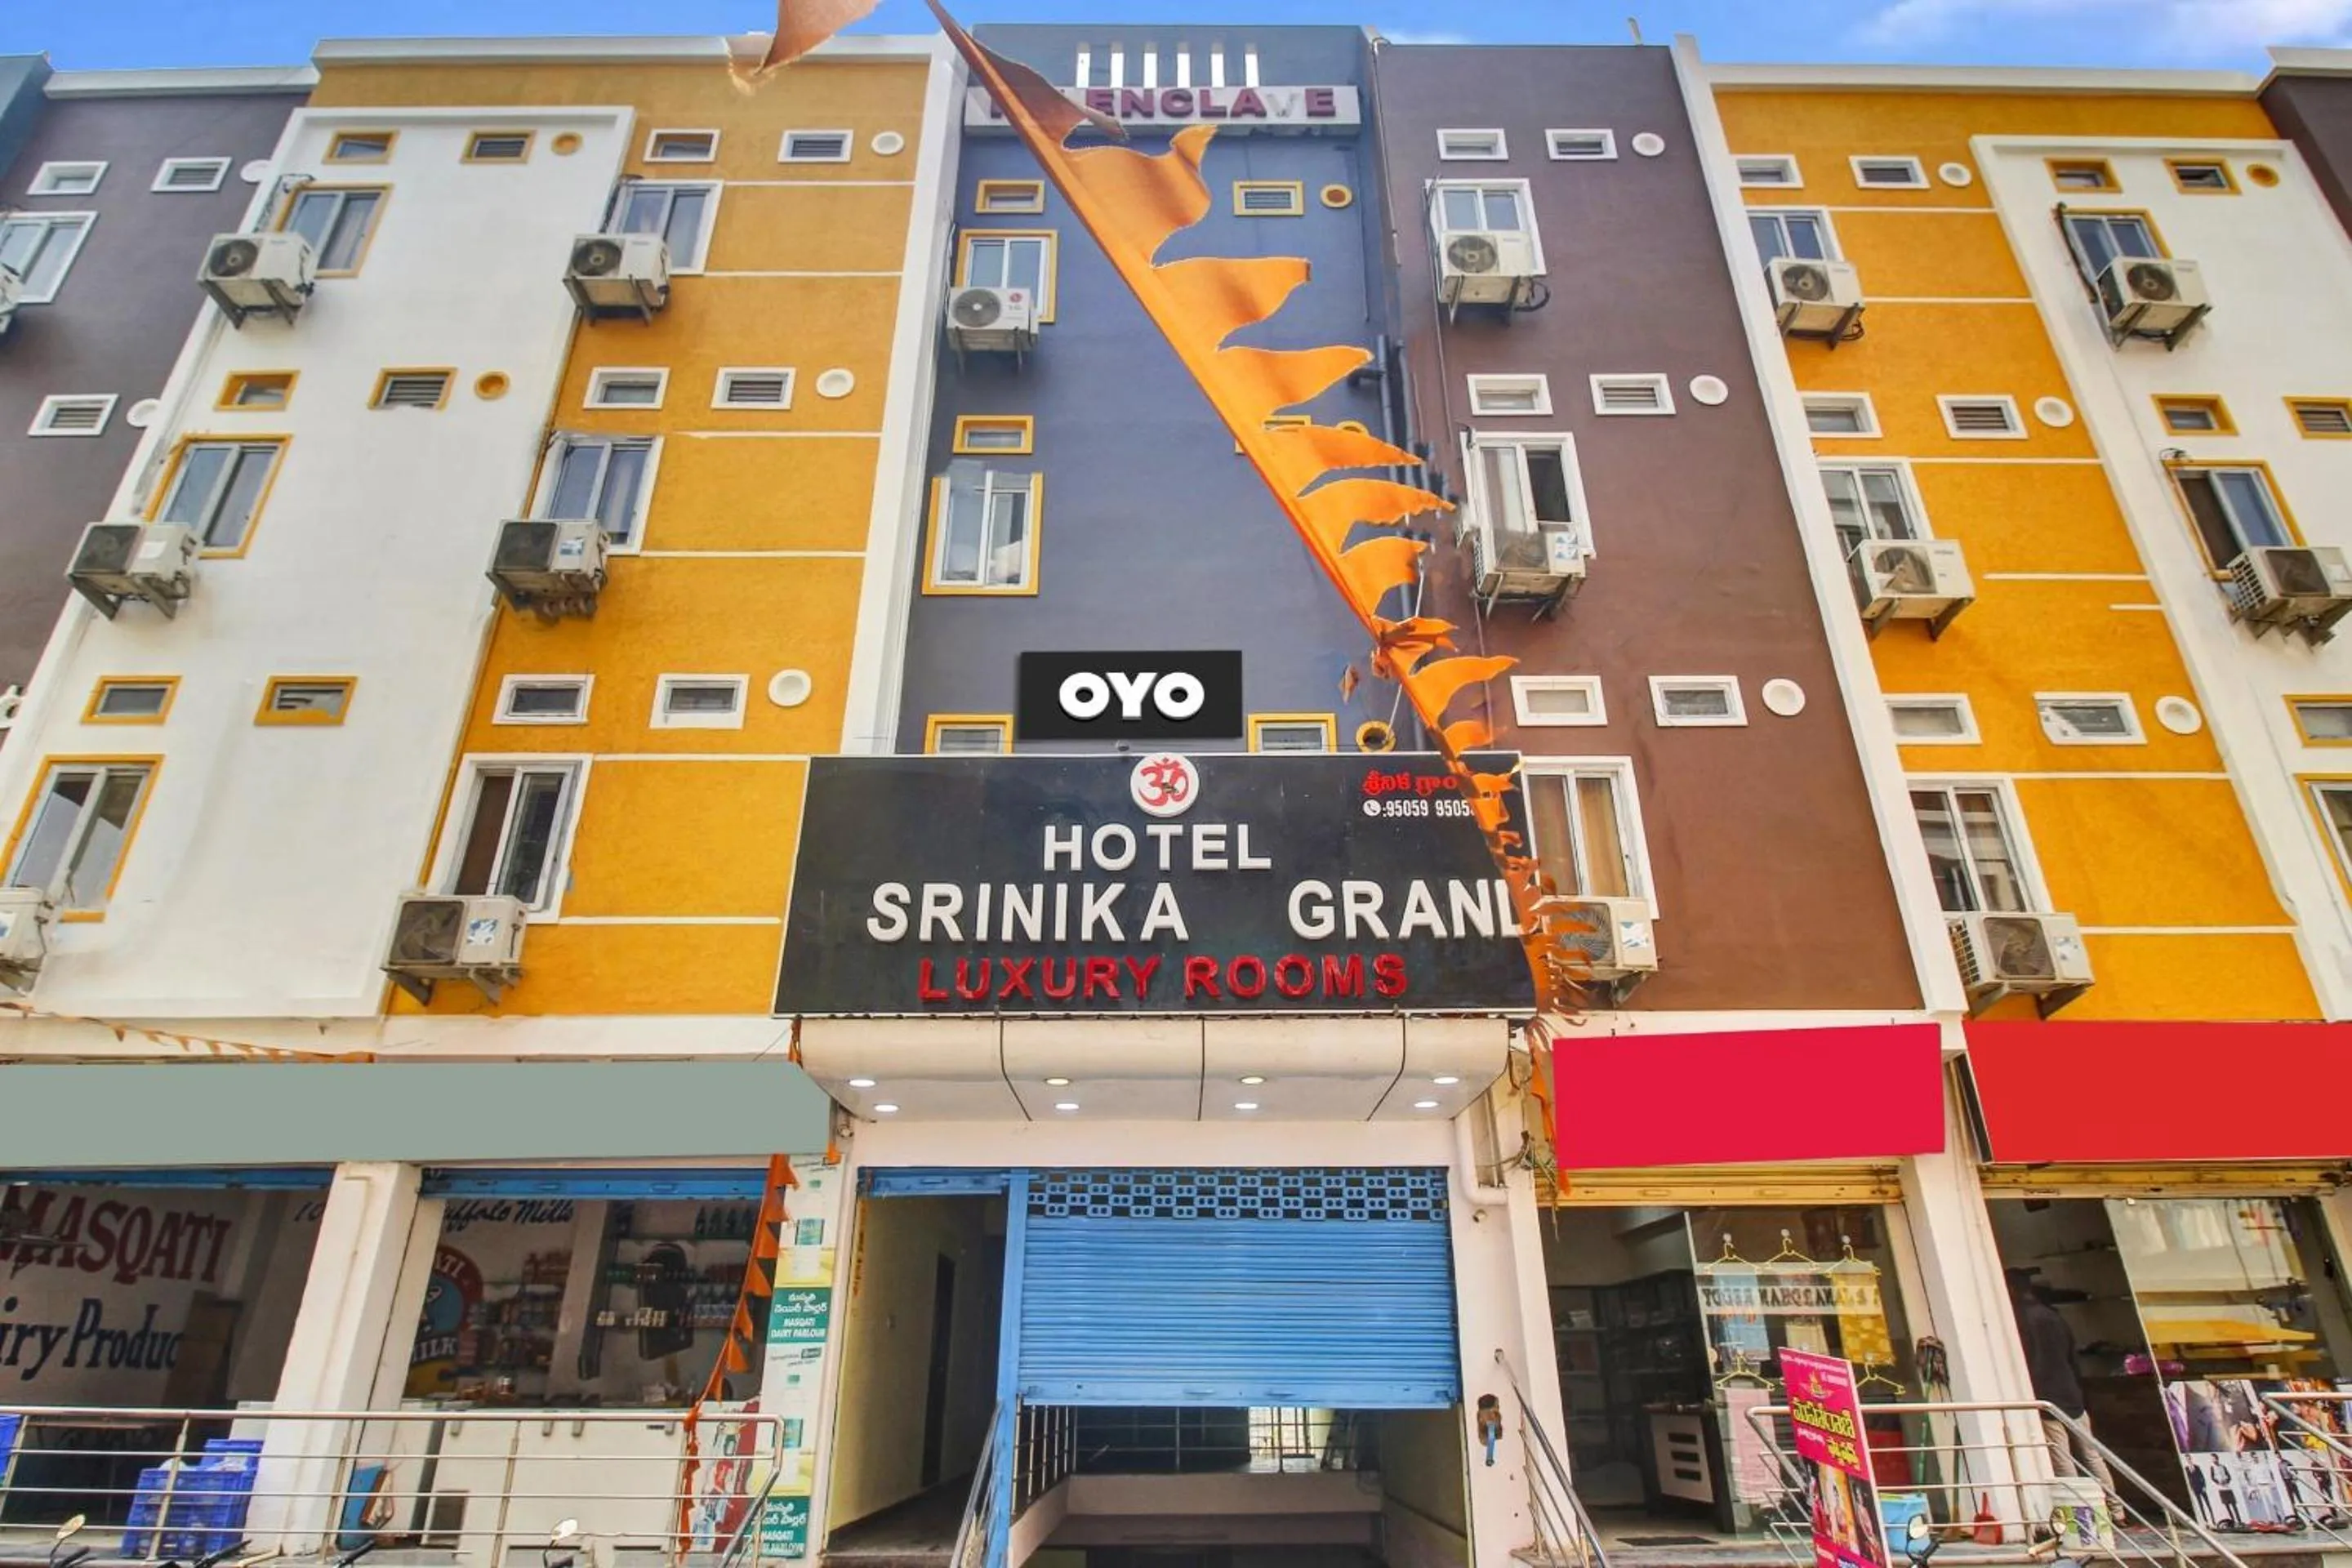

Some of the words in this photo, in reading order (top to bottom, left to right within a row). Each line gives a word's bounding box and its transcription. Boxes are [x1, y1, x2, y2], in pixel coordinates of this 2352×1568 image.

[1085, 87, 1336, 118] ENCLAVE
[1058, 671, 1205, 720] OYO
[1435, 800, 1475, 816] 9505
[1043, 823, 1272, 872] HOTEL
[866, 882, 1189, 943] SRINIKA
[918, 956, 1161, 1001] LUXURY
[1183, 953, 1408, 1000] ROOMS
[62, 1298, 185, 1371] Produc
